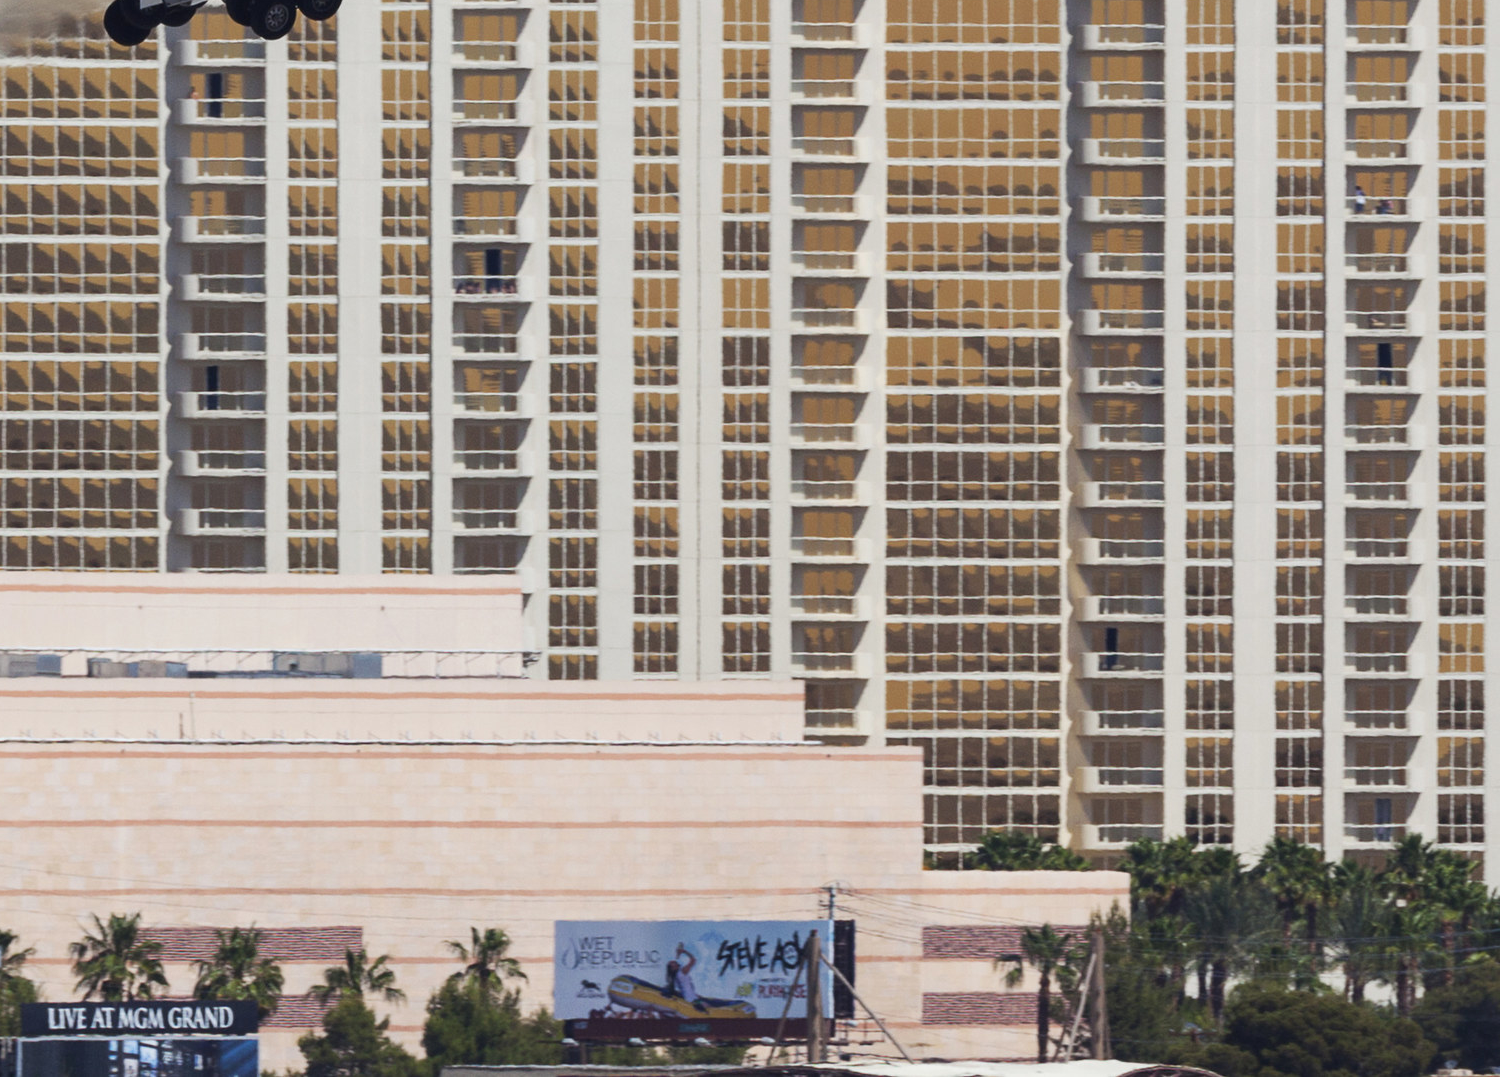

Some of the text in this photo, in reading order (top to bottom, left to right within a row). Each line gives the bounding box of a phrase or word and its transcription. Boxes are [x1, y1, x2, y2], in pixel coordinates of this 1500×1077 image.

[579, 936, 614, 950] WET
[579, 950, 661, 965] REPUBLIC
[716, 934, 769, 977] STEVE
[48, 1006, 234, 1029] LIVE AT MGM GRAND
